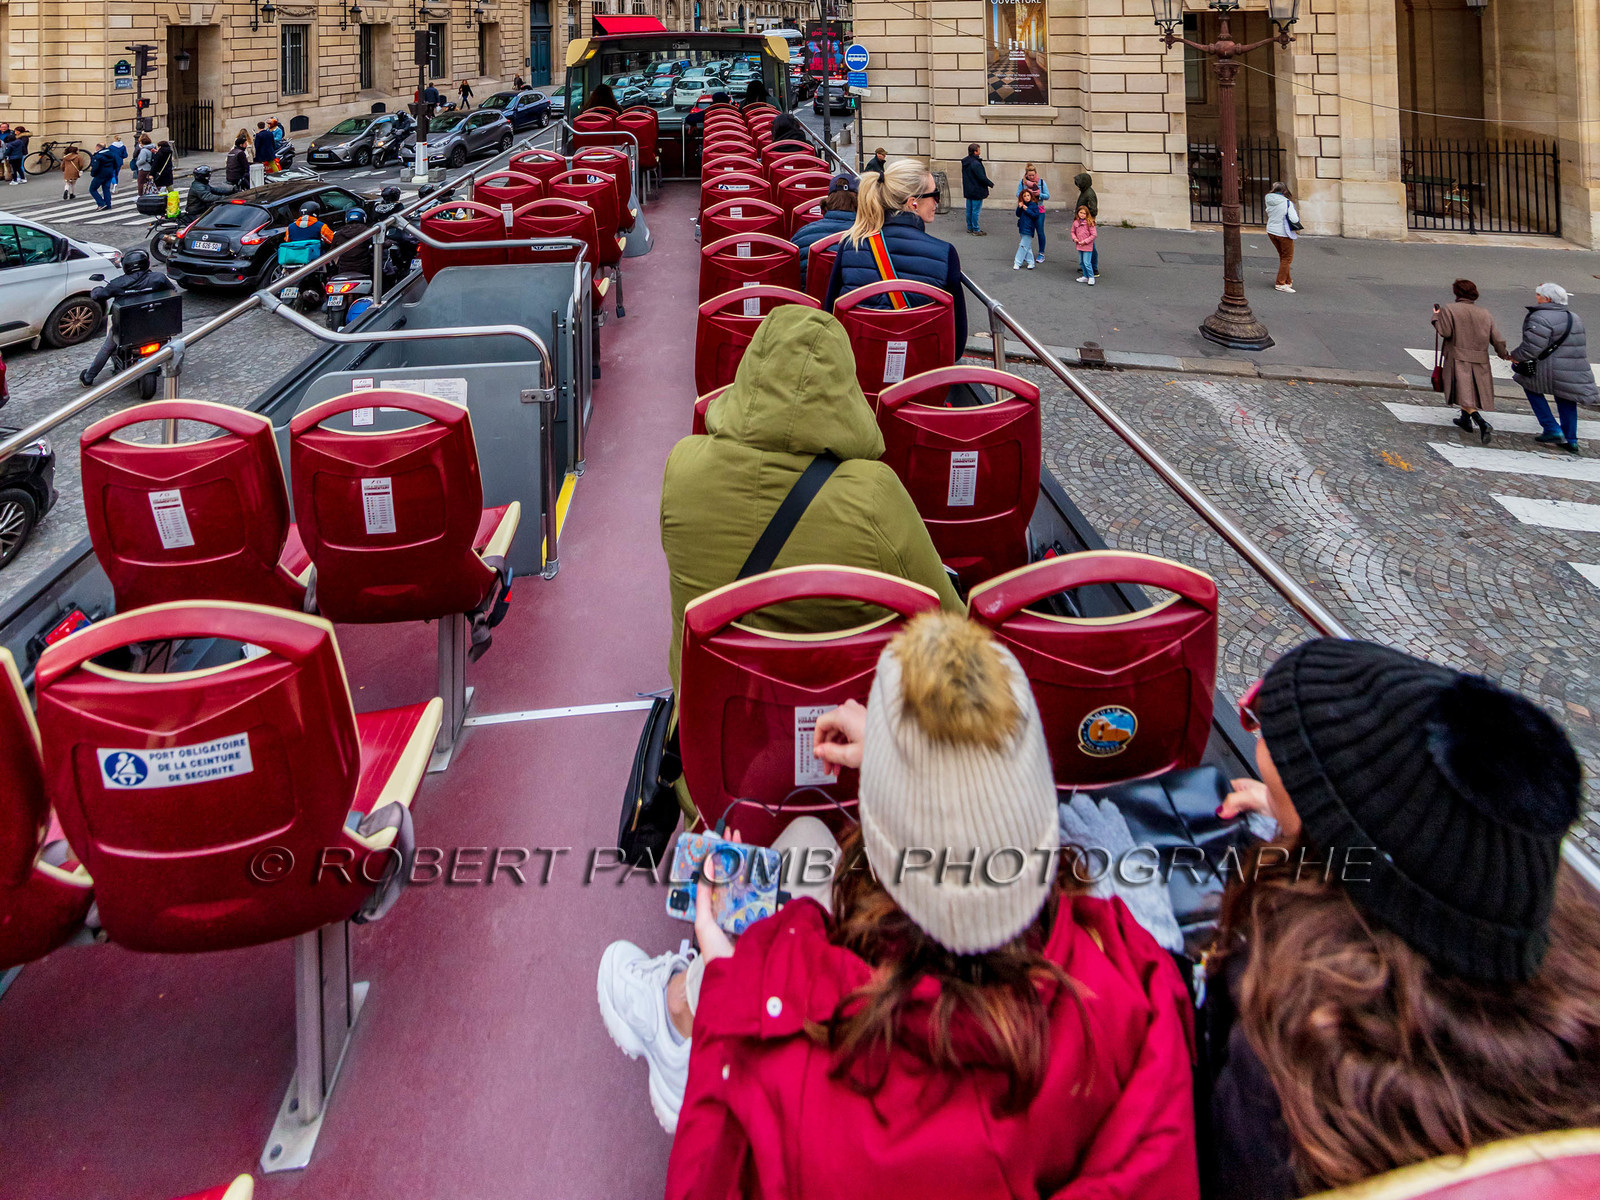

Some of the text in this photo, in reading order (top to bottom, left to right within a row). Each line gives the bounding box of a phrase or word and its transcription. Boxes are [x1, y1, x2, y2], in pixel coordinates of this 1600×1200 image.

[149, 738, 246, 760] PORT OBLIGATOIRE
[158, 751, 241, 772] DE LA CEINTURE
[168, 764, 235, 782] DE SECURITE
